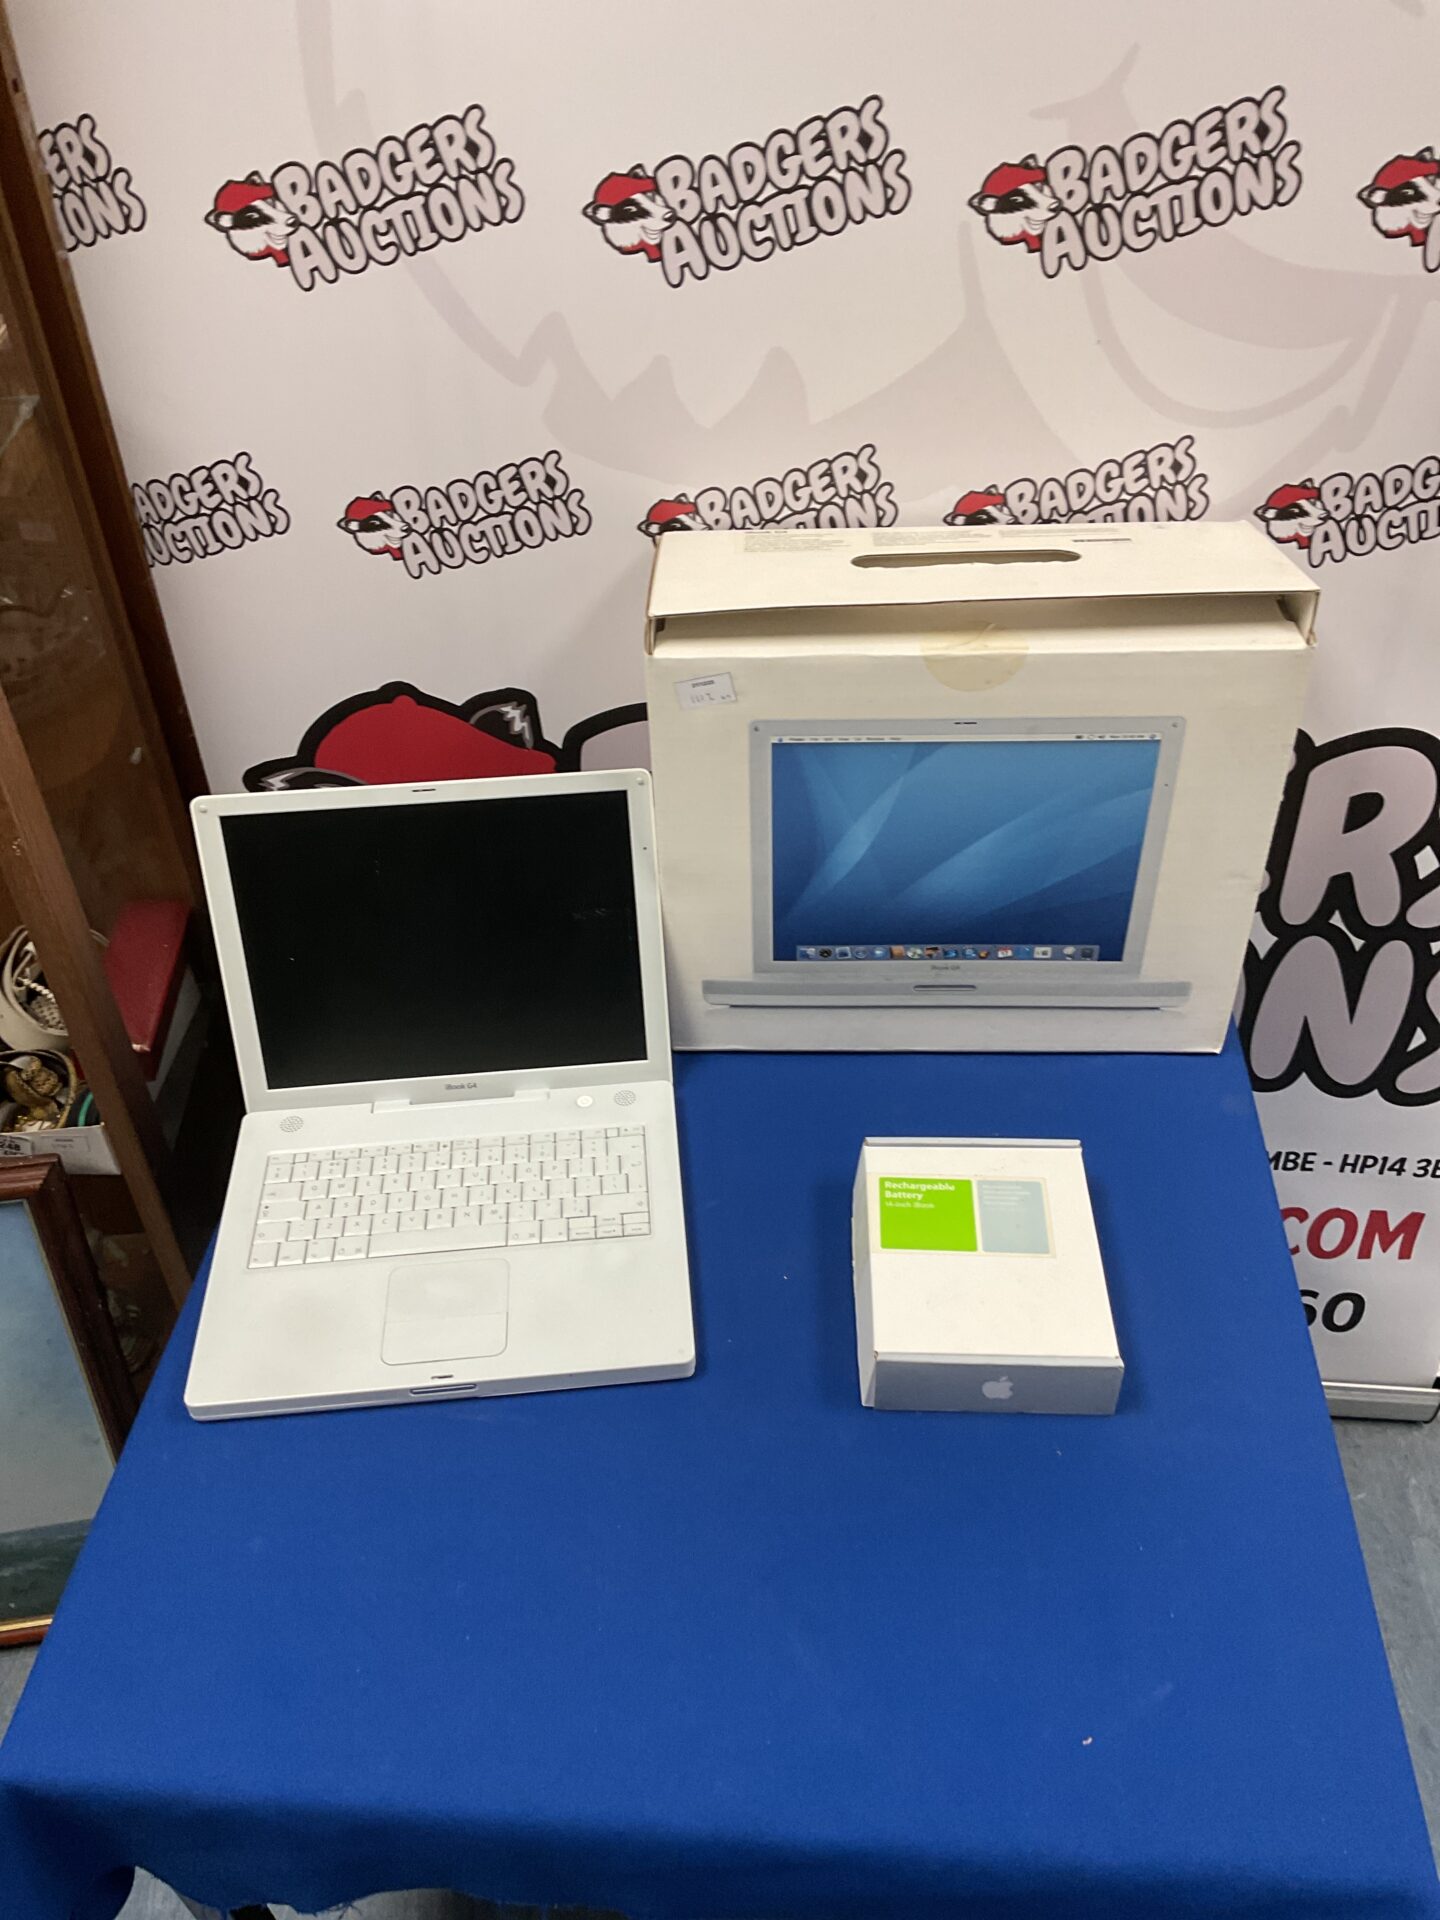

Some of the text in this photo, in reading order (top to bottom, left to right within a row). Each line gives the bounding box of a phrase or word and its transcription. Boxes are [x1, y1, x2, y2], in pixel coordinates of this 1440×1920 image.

[272, 104, 496, 228] BADGERS
[654, 95, 889, 223] BADGERS
[1045, 85, 1287, 206] BADGERS
[287, 158, 525, 291] AUCTIONS
[659, 148, 912, 288] AUCTIONS
[1039, 140, 1302, 278] AUCTIONS
[392, 450, 570, 535] BADGERS
[694, 443, 880, 530] BADGERS
[1004, 435, 1197, 525] BADGERS
[400, 489, 592, 579] AUCTIONS
[884, 1180, 956, 1192] Rechargeable
[884, 1190, 925, 1201] Battery
[1339, 1154, 1408, 1177] HP14
